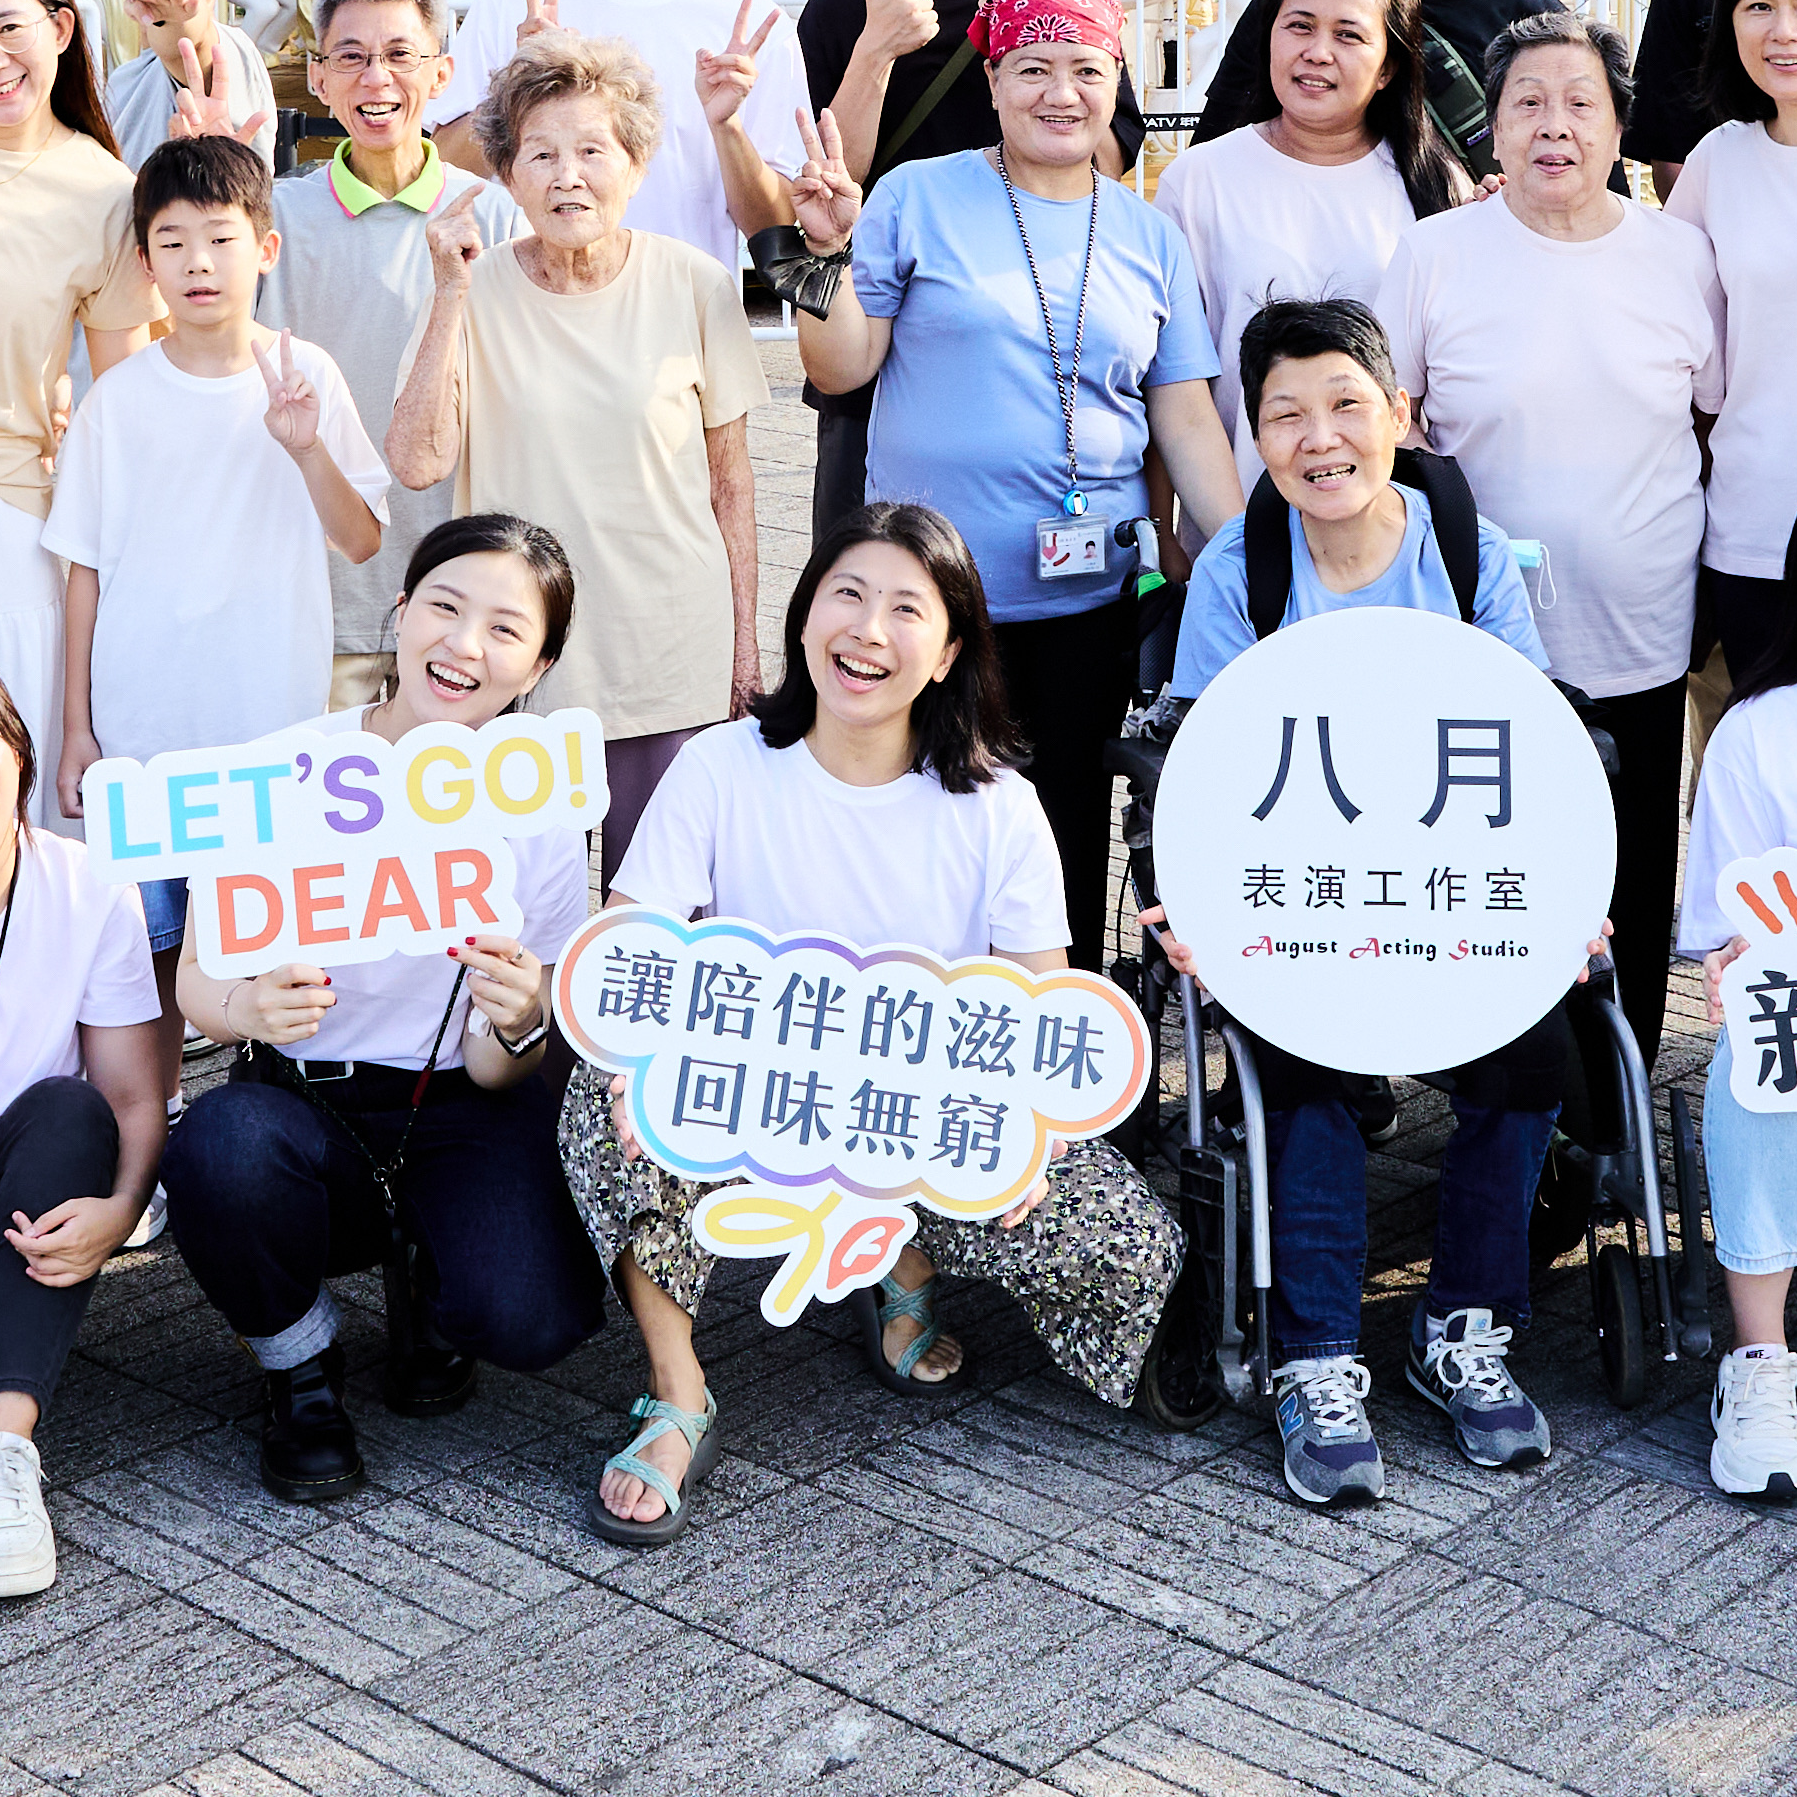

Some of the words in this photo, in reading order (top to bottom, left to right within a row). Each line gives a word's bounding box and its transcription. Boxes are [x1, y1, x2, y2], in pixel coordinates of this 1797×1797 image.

[105, 752, 386, 861] LET'S
[405, 730, 589, 825] GO!
[1251, 715, 1512, 829] 八月
[214, 847, 501, 956] DEAR
[1242, 863, 1529, 912] 表演工作室
[1241, 935, 1338, 959] August
[1348, 937, 1438, 962] Acting
[1448, 939, 1530, 961] Studio
[597, 945, 1106, 1090] 讓陪伴的滋味
[670, 1054, 1010, 1174] 回味無窮
